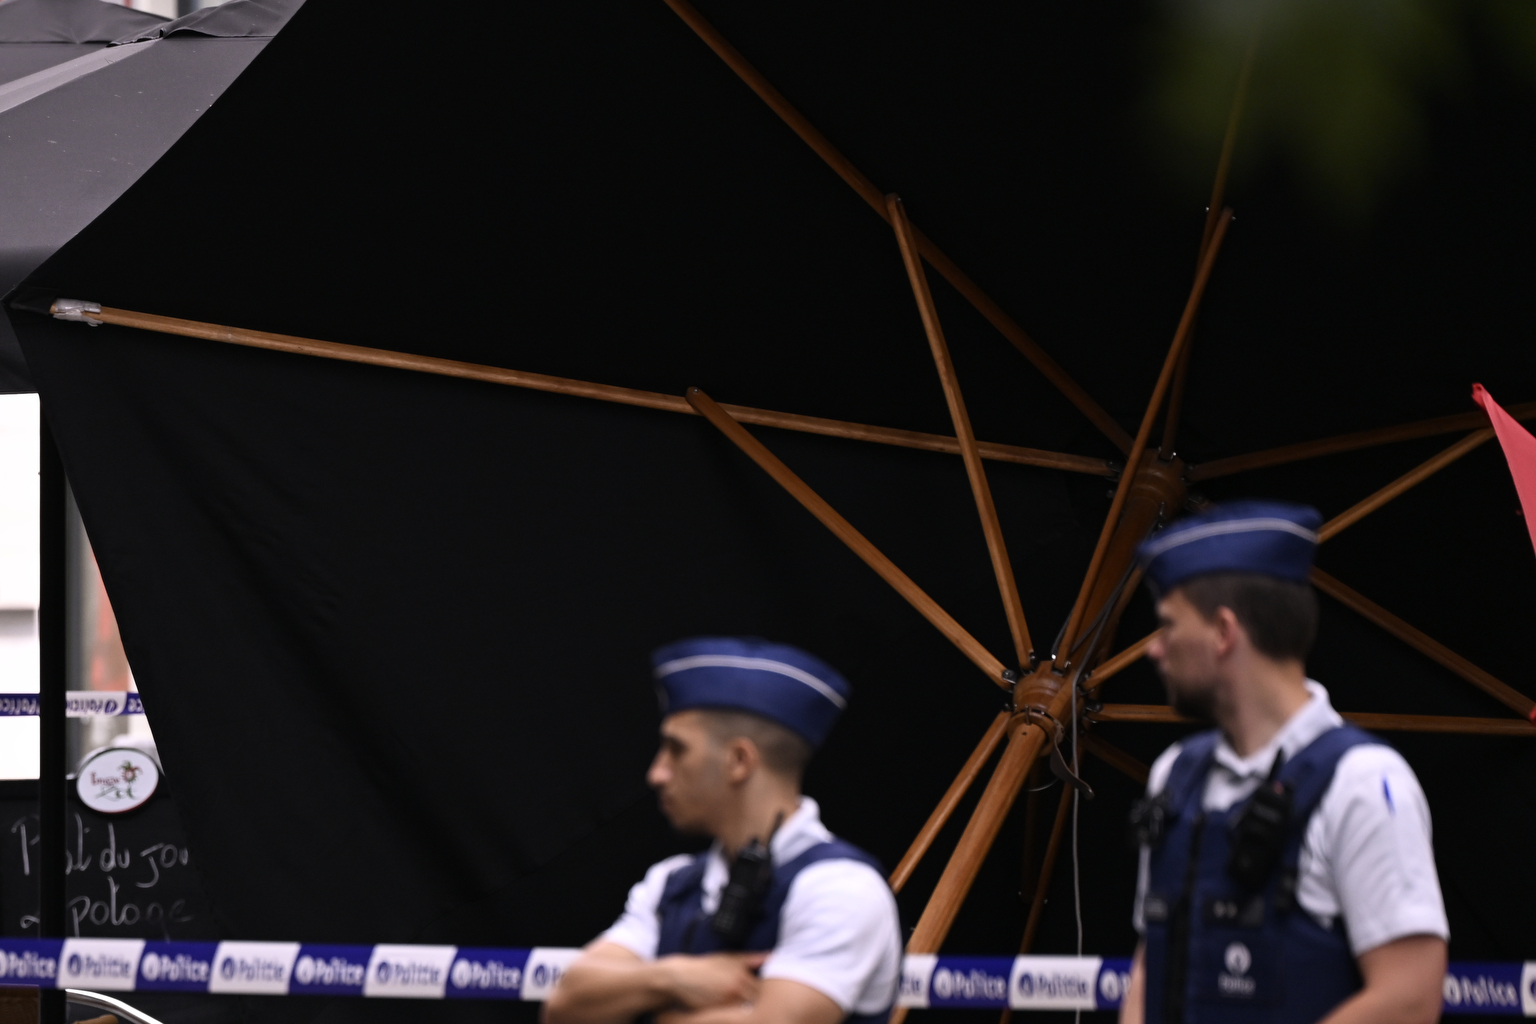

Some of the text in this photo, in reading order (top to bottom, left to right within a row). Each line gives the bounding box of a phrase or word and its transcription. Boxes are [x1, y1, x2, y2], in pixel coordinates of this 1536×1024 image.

[99, 822, 130, 871] du
[8, 951, 57, 978] Police
[85, 952, 133, 978] Politie
[159, 954, 209, 981] Police
[237, 957, 284, 982] Politie
[314, 957, 364, 985] Police
[392, 958, 442, 985] Politie
[470, 960, 521, 989] Police
[953, 969, 1006, 999] Police
[1037, 971, 1088, 999] Politie
[1464, 975, 1518, 1006] Police
